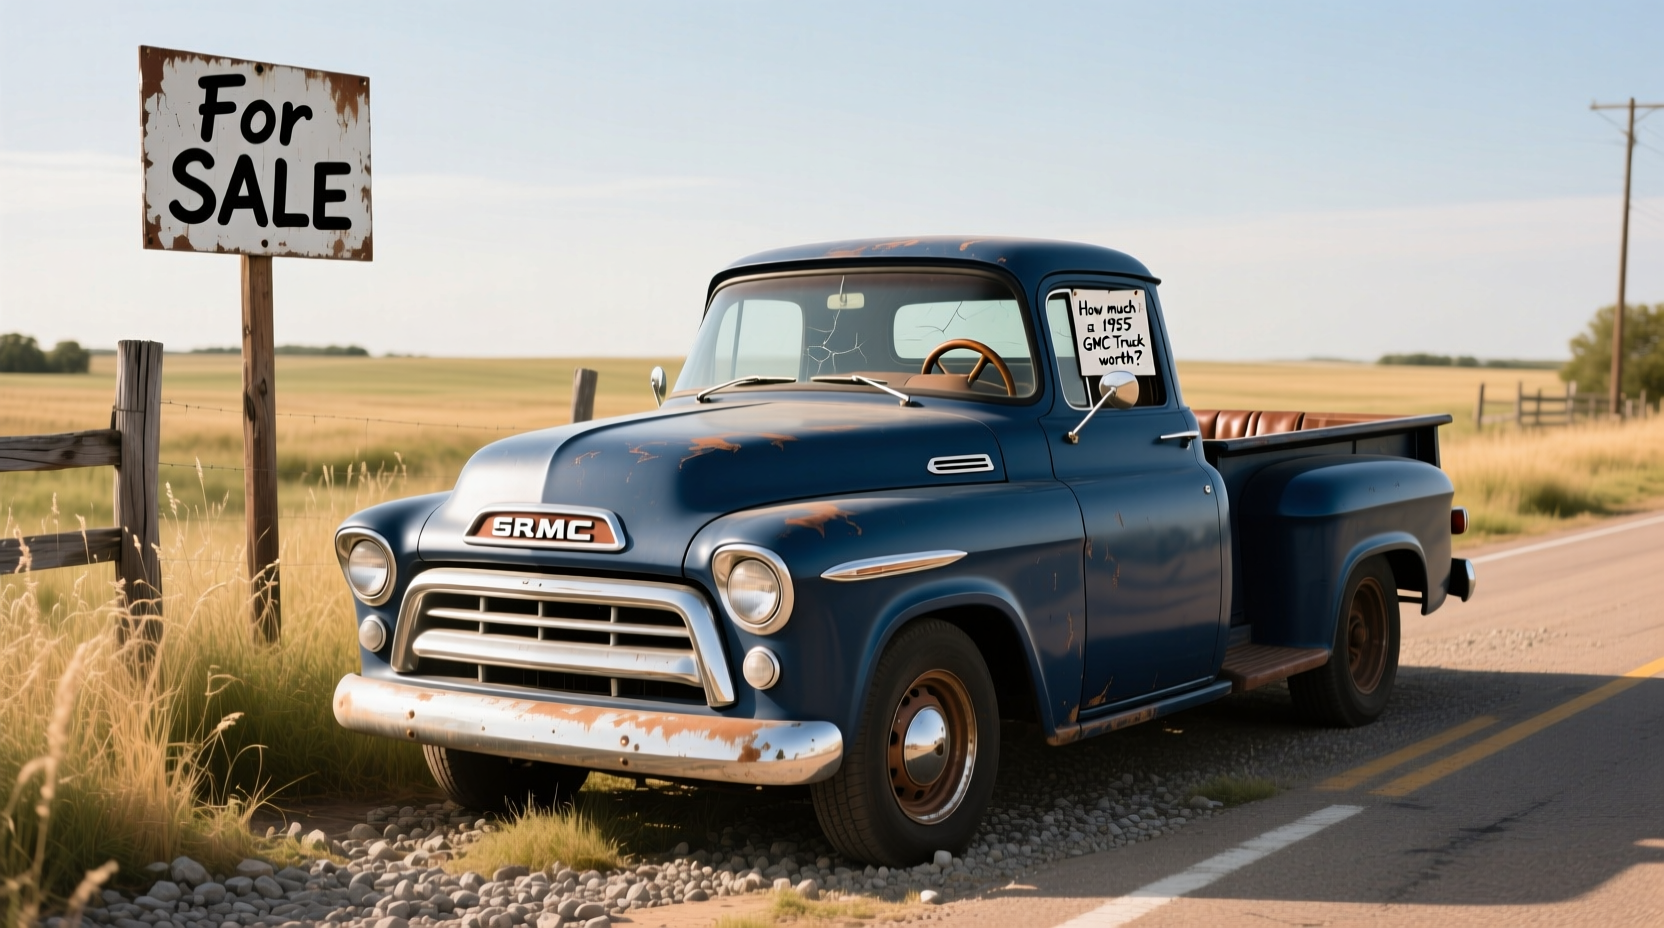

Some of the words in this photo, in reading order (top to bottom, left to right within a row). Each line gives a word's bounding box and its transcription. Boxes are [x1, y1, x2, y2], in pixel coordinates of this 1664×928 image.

[198, 73, 313, 146] For
[169, 147, 352, 230] SALE
[1079, 300, 1103, 316] How
[1107, 299, 1136, 314] much
[1103, 317, 1132, 332] 1955
[1083, 335, 1111, 351] GMC
[1112, 333, 1145, 349] Truck
[1099, 350, 1143, 366] worth?
